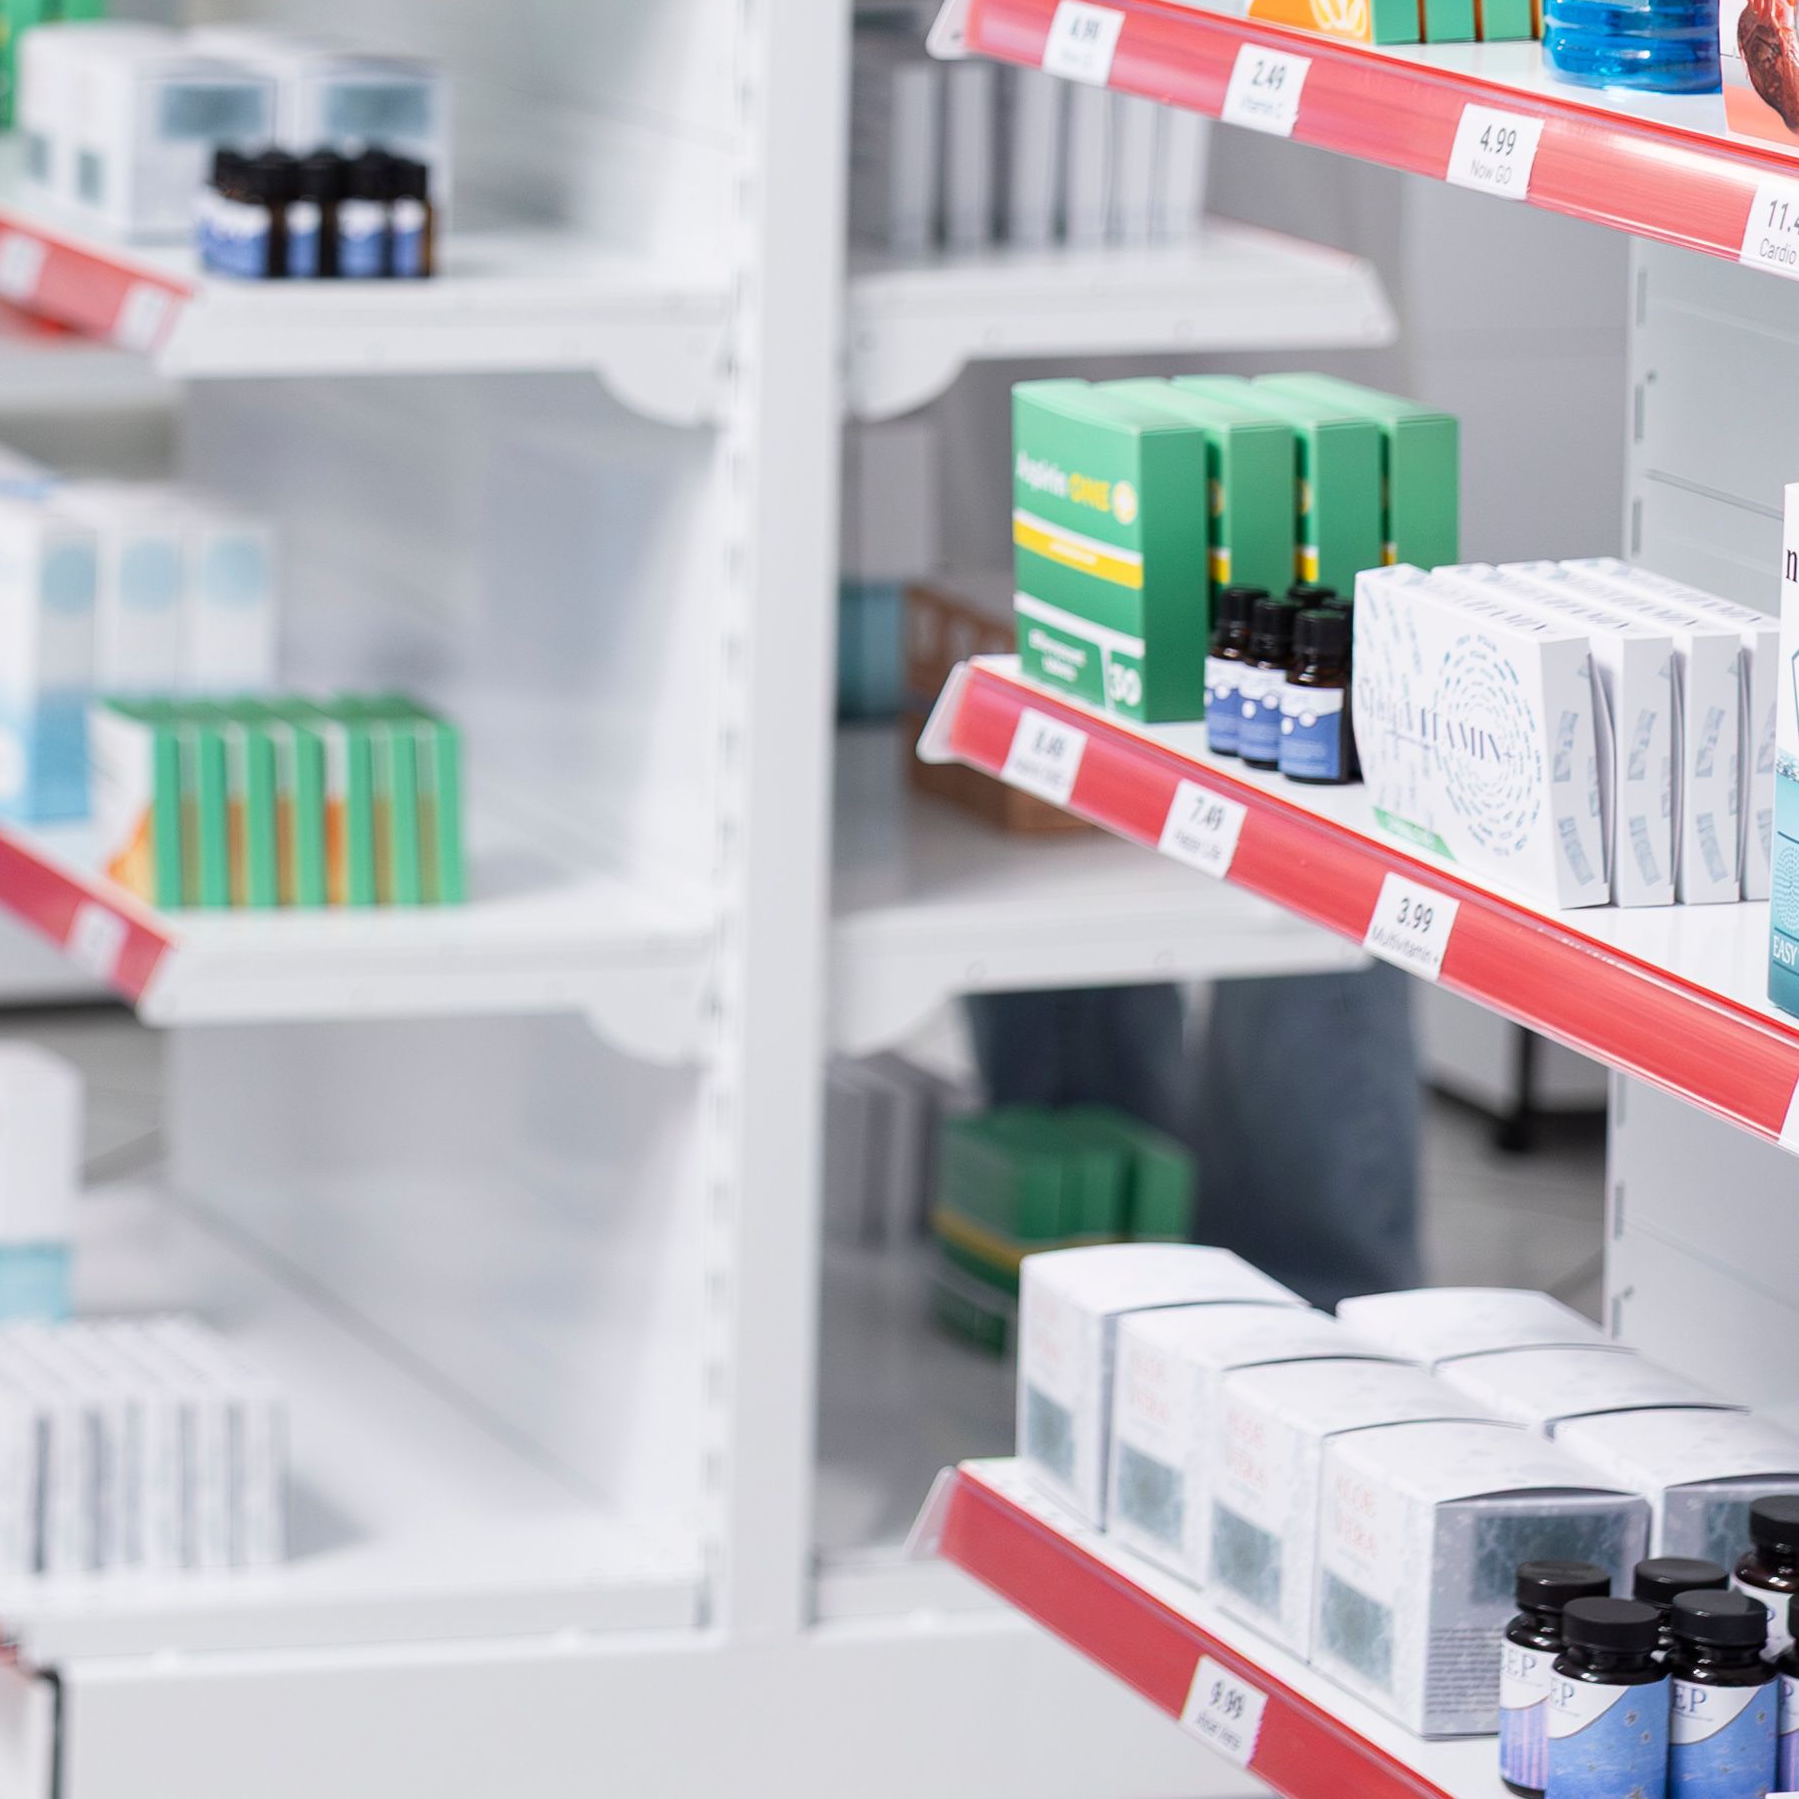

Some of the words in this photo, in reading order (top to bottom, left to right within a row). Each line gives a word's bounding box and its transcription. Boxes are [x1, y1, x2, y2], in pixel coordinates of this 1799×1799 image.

[1480, 124, 1517, 156] 4.99
[1495, 164, 1513, 185] GO
[1759, 237, 1797, 265] Cardio
[1397, 897, 1433, 933] 3.99
